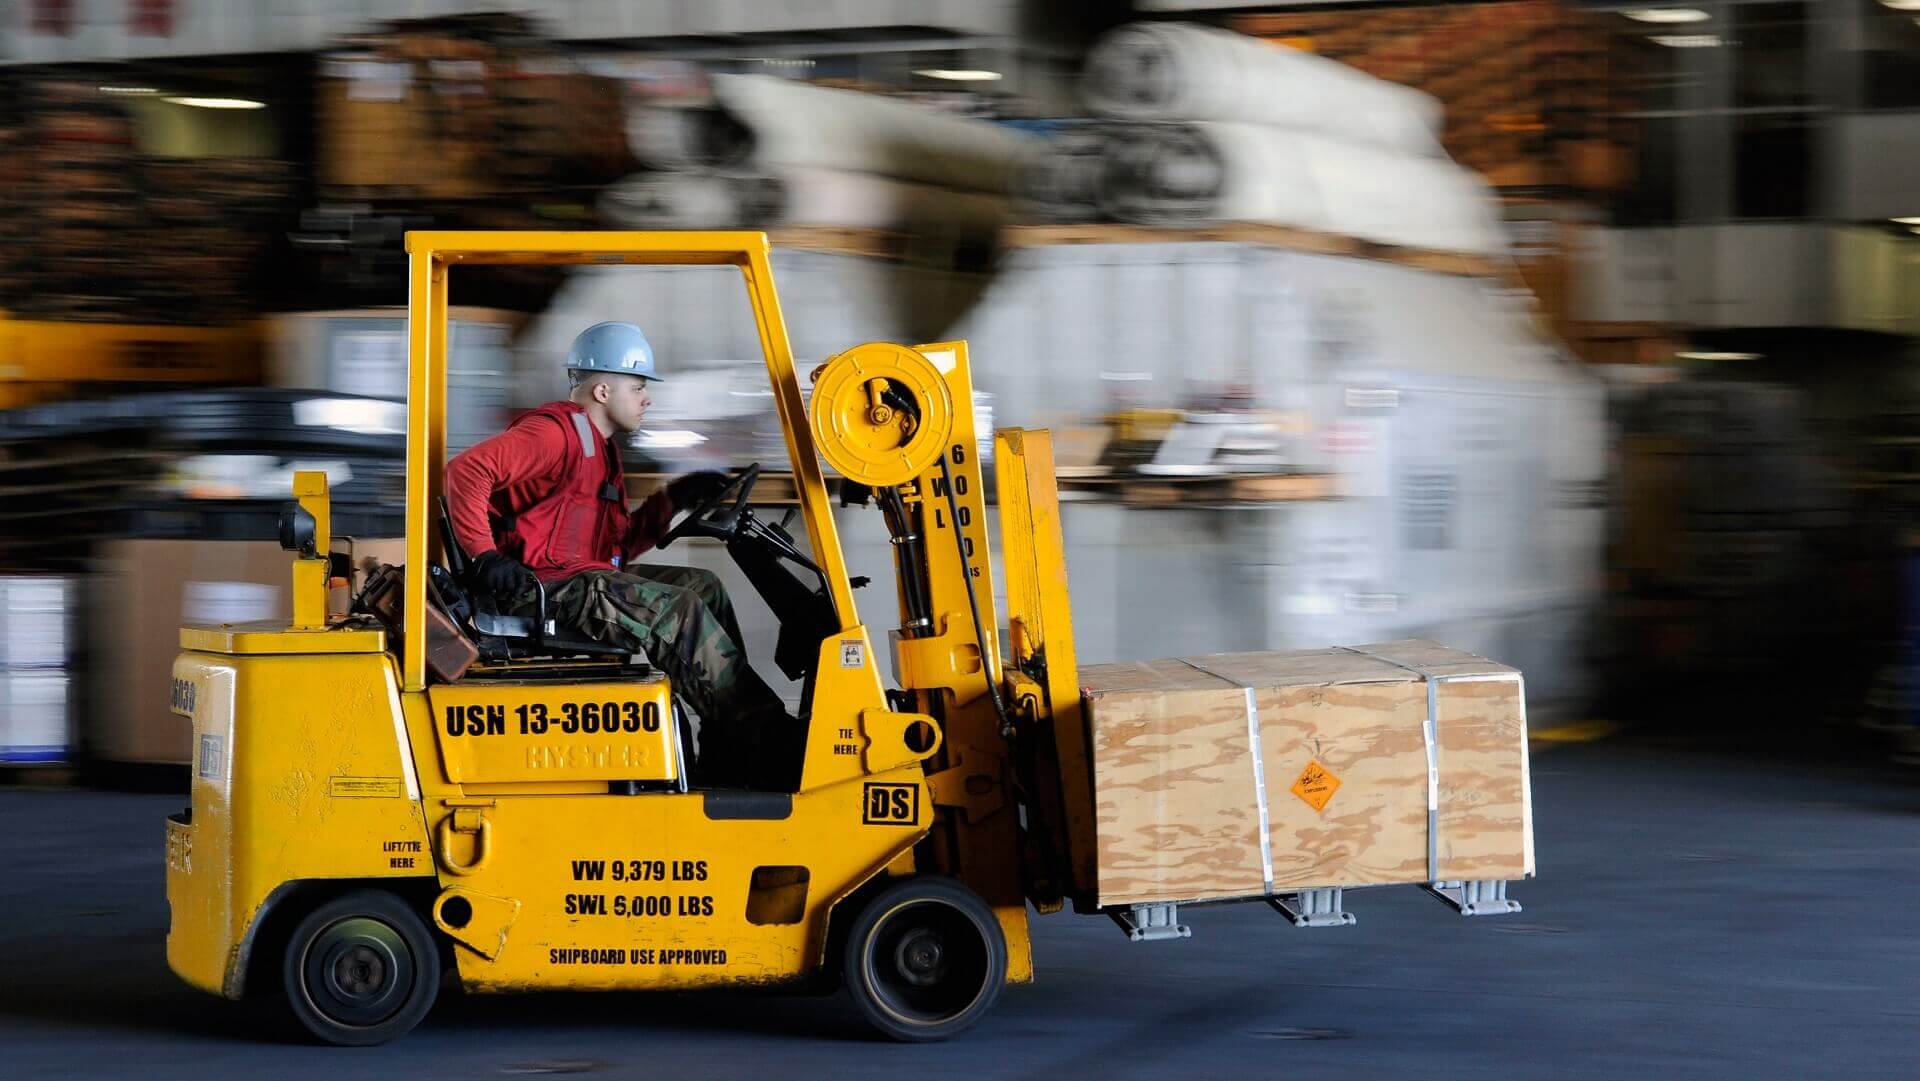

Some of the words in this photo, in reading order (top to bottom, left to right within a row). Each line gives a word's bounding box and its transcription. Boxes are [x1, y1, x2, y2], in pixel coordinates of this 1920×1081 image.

[446, 705, 505, 737] USN
[515, 701, 660, 734] 13-36030
[838, 728, 854, 739] TIE
[526, 744, 651, 769] HYSTER
[834, 744, 858, 755] HERE
[871, 788, 910, 820] DS
[383, 841, 421, 852] LIFT/TIE
[390, 857, 414, 868] HERE
[572, 860, 605, 881] VW
[611, 860, 666, 883] 9,379
[672, 860, 708, 881] LBS
[565, 894, 607, 915] SWL
[678, 895, 714, 916] LBS
[550, 948, 626, 964] SHIPBOARD
[630, 949, 655, 964] USE
[658, 949, 727, 964] APPROVED
